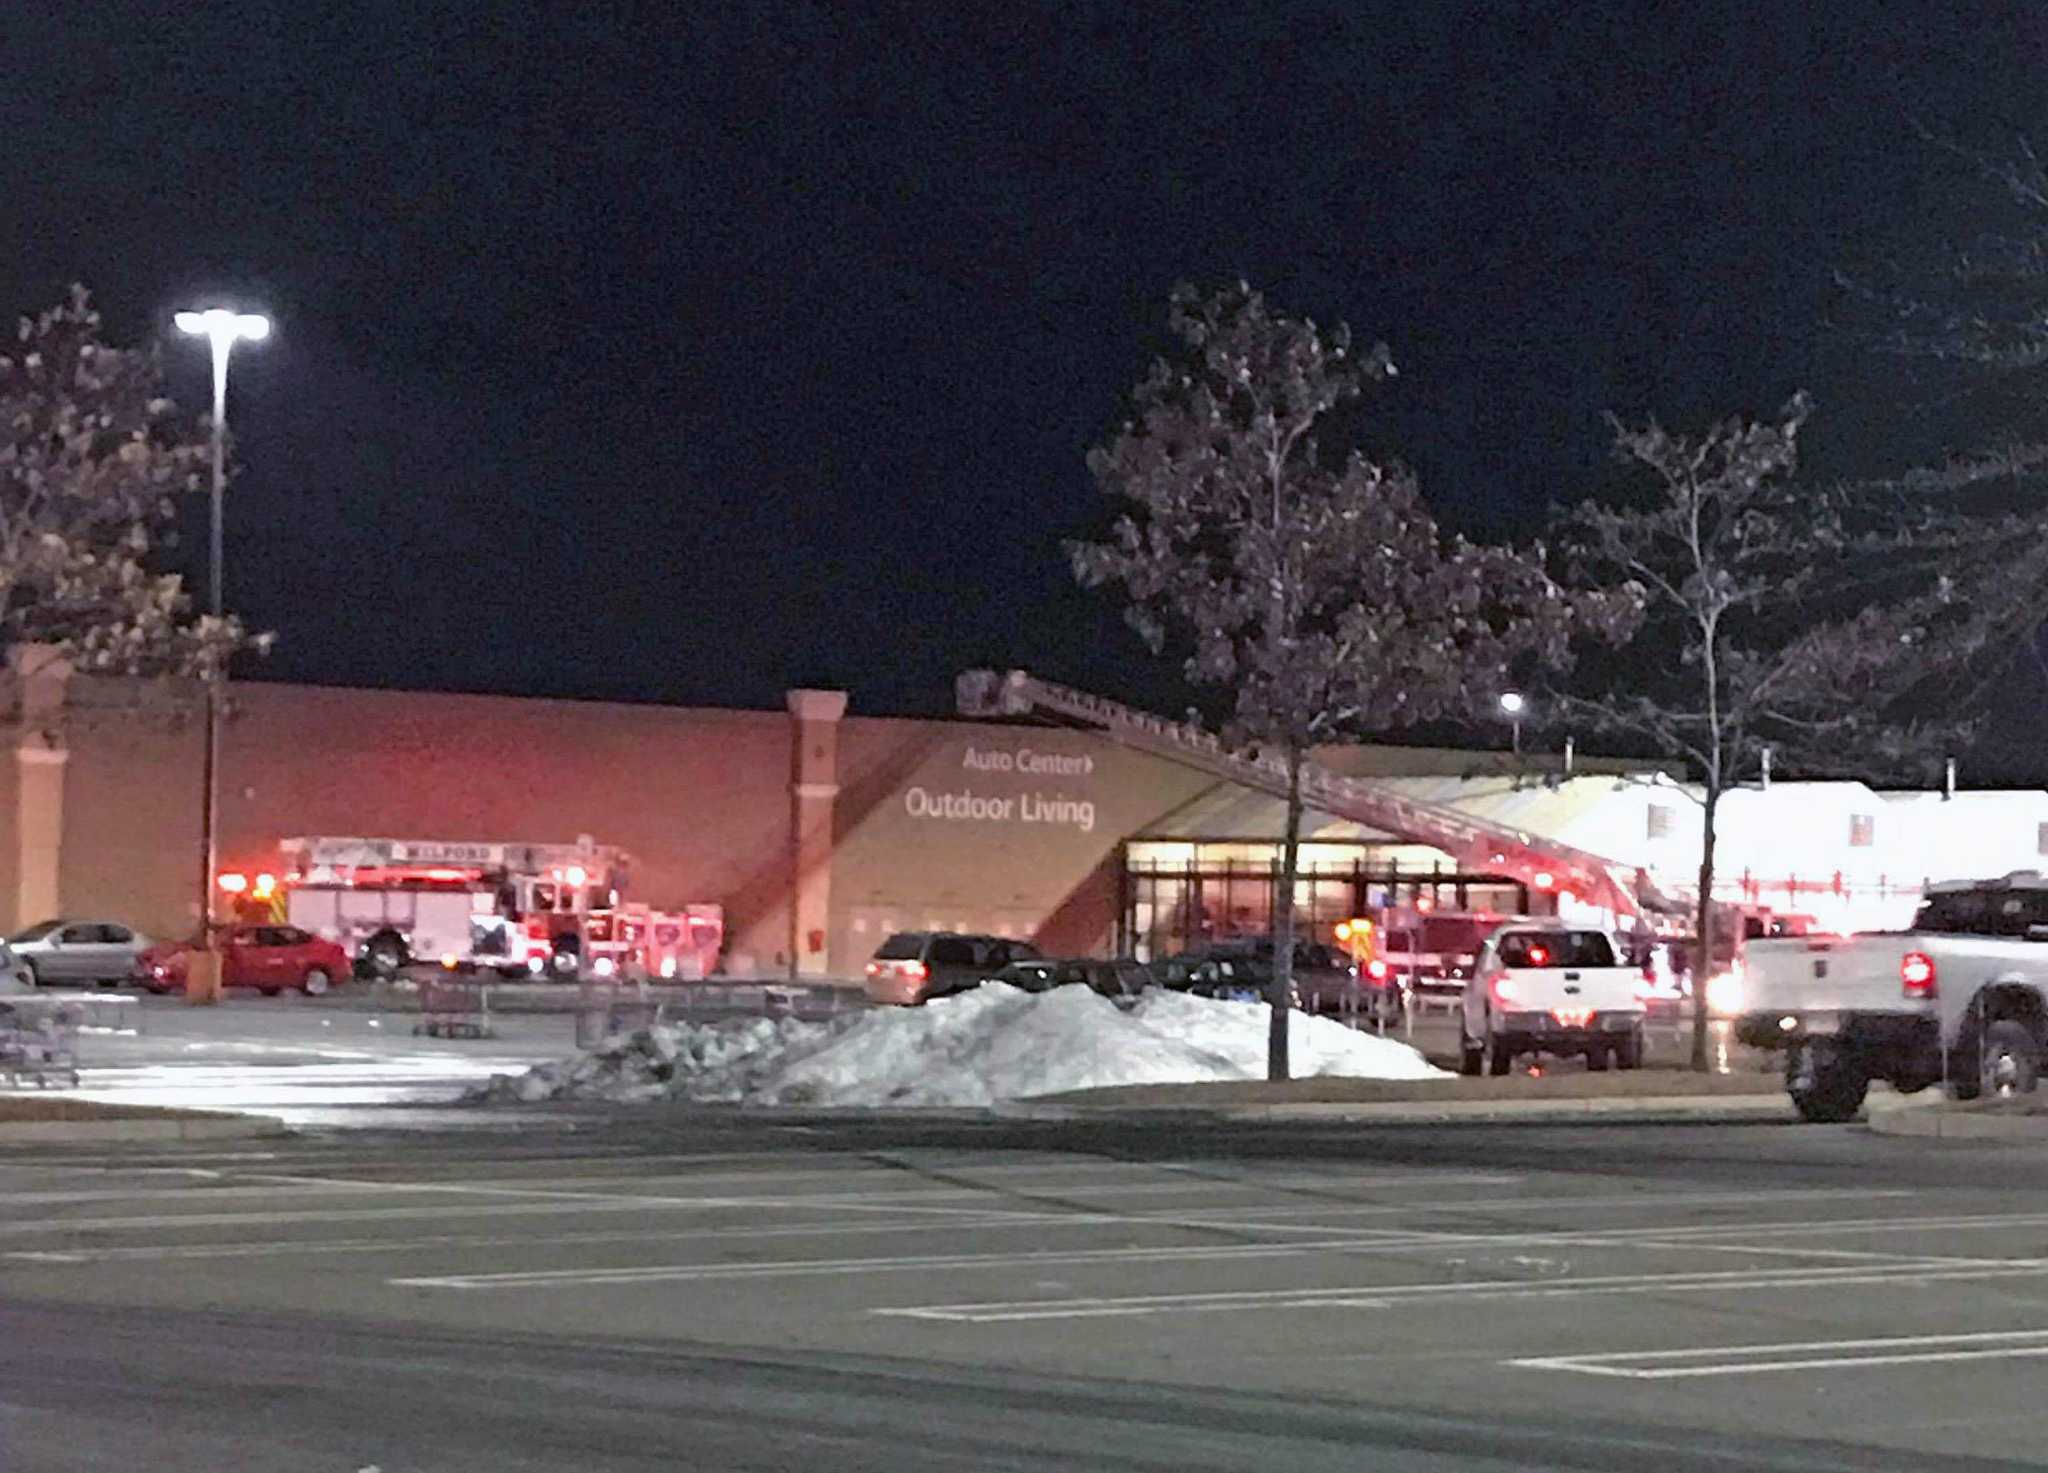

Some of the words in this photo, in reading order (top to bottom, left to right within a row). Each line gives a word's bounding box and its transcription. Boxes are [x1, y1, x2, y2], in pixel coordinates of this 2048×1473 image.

[962, 747, 1013, 771] Auto
[1016, 749, 1084, 774] Center
[905, 786, 1012, 818] Outdoor
[1021, 792, 1095, 831] Living
